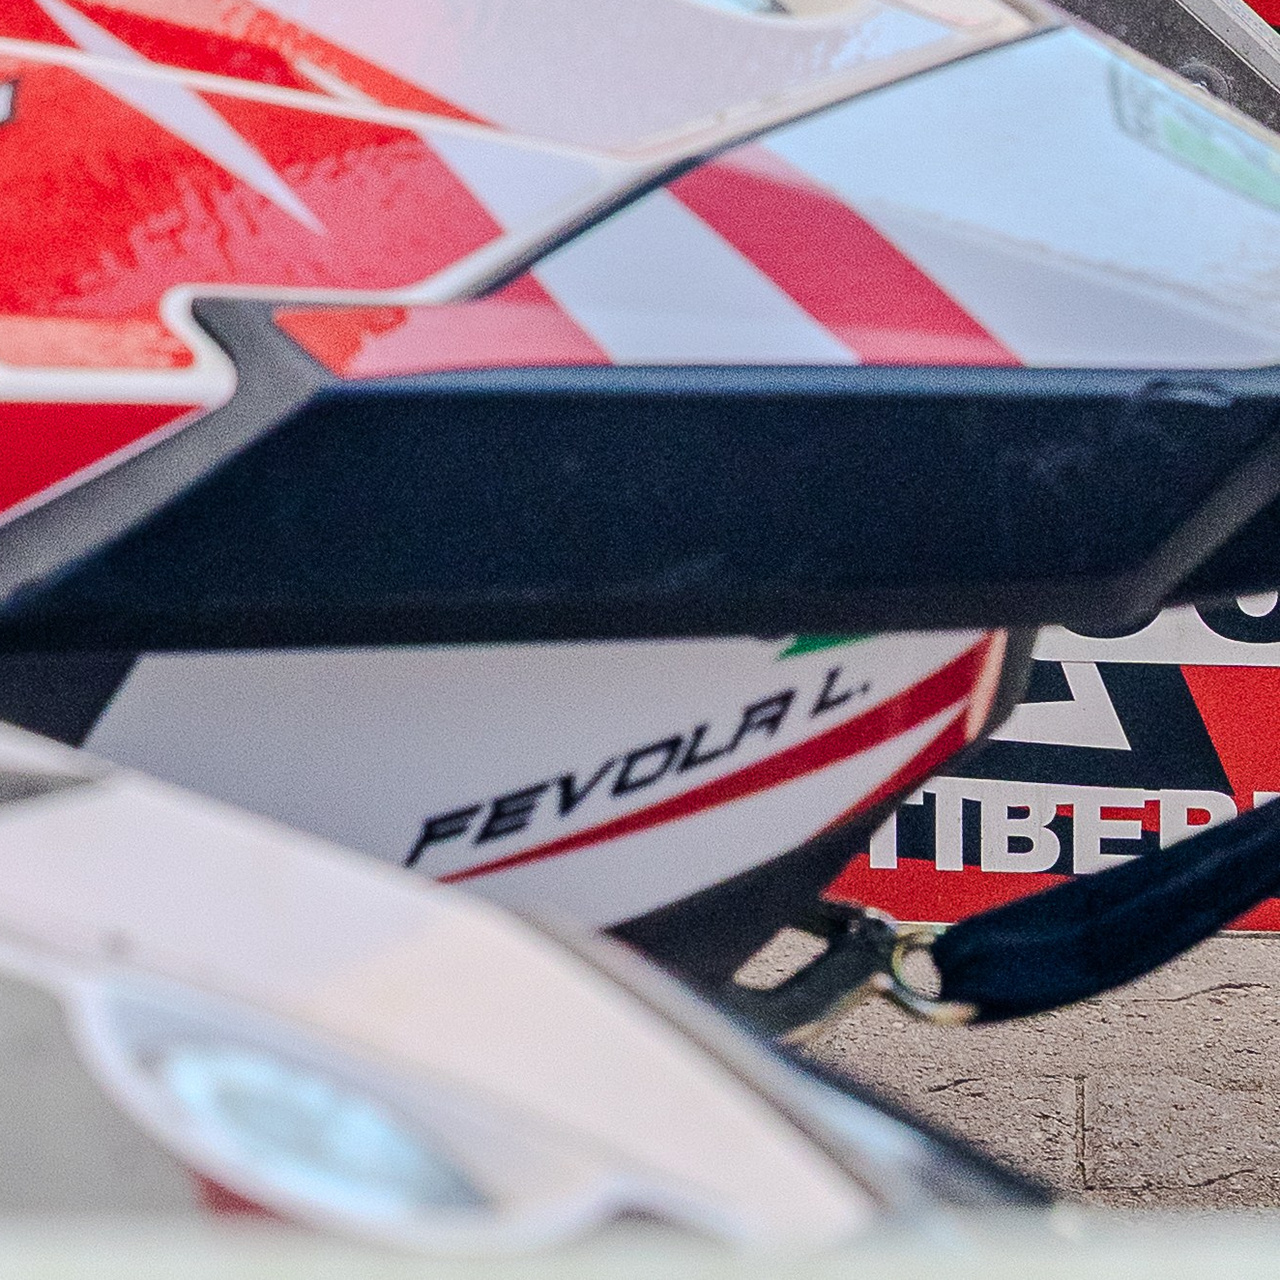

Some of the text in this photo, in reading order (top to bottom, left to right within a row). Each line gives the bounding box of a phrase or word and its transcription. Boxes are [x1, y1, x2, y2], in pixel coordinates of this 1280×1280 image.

[403, 665, 871, 870] FEVOLA L.
[869, 775, 1280, 876] TIBER
